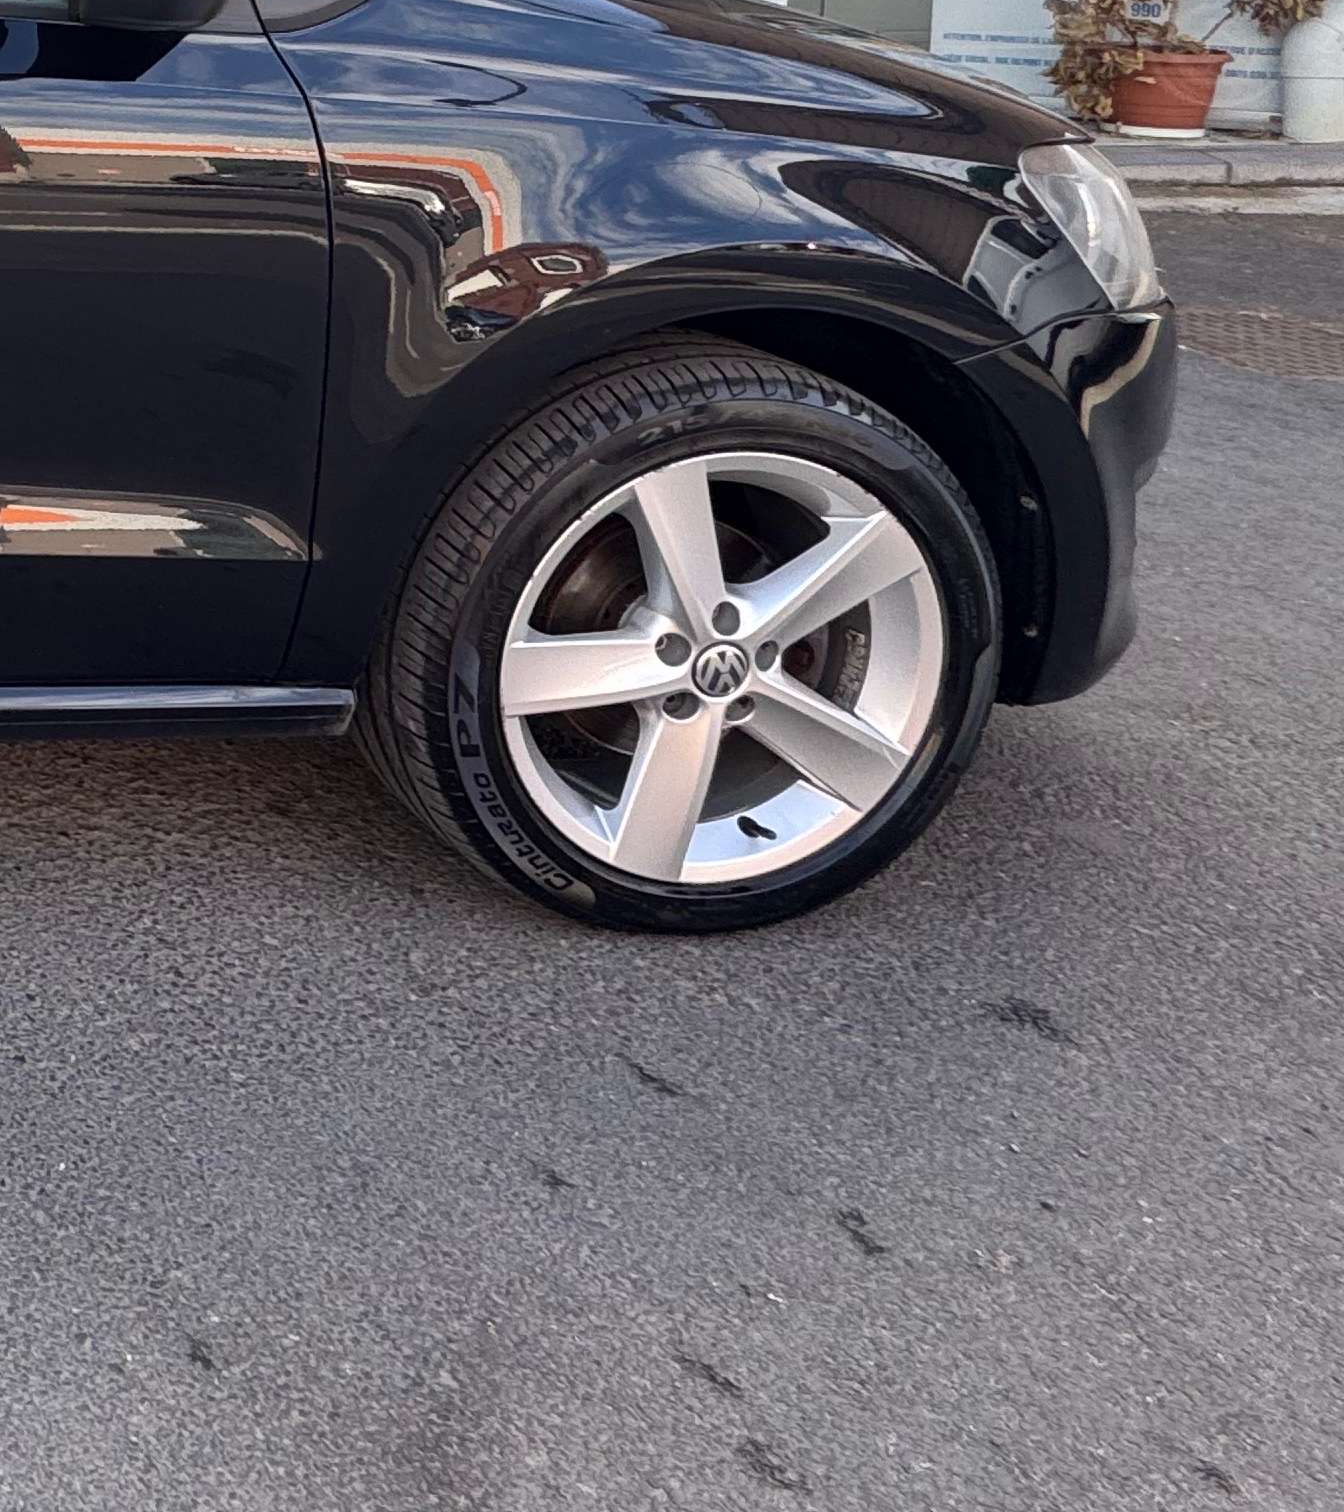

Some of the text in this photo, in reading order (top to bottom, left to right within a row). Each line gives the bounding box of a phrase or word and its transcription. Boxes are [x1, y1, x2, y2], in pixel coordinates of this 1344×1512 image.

[1130, 2, 1161, 17] 990
[453, 672, 574, 890] Cinturato P7
